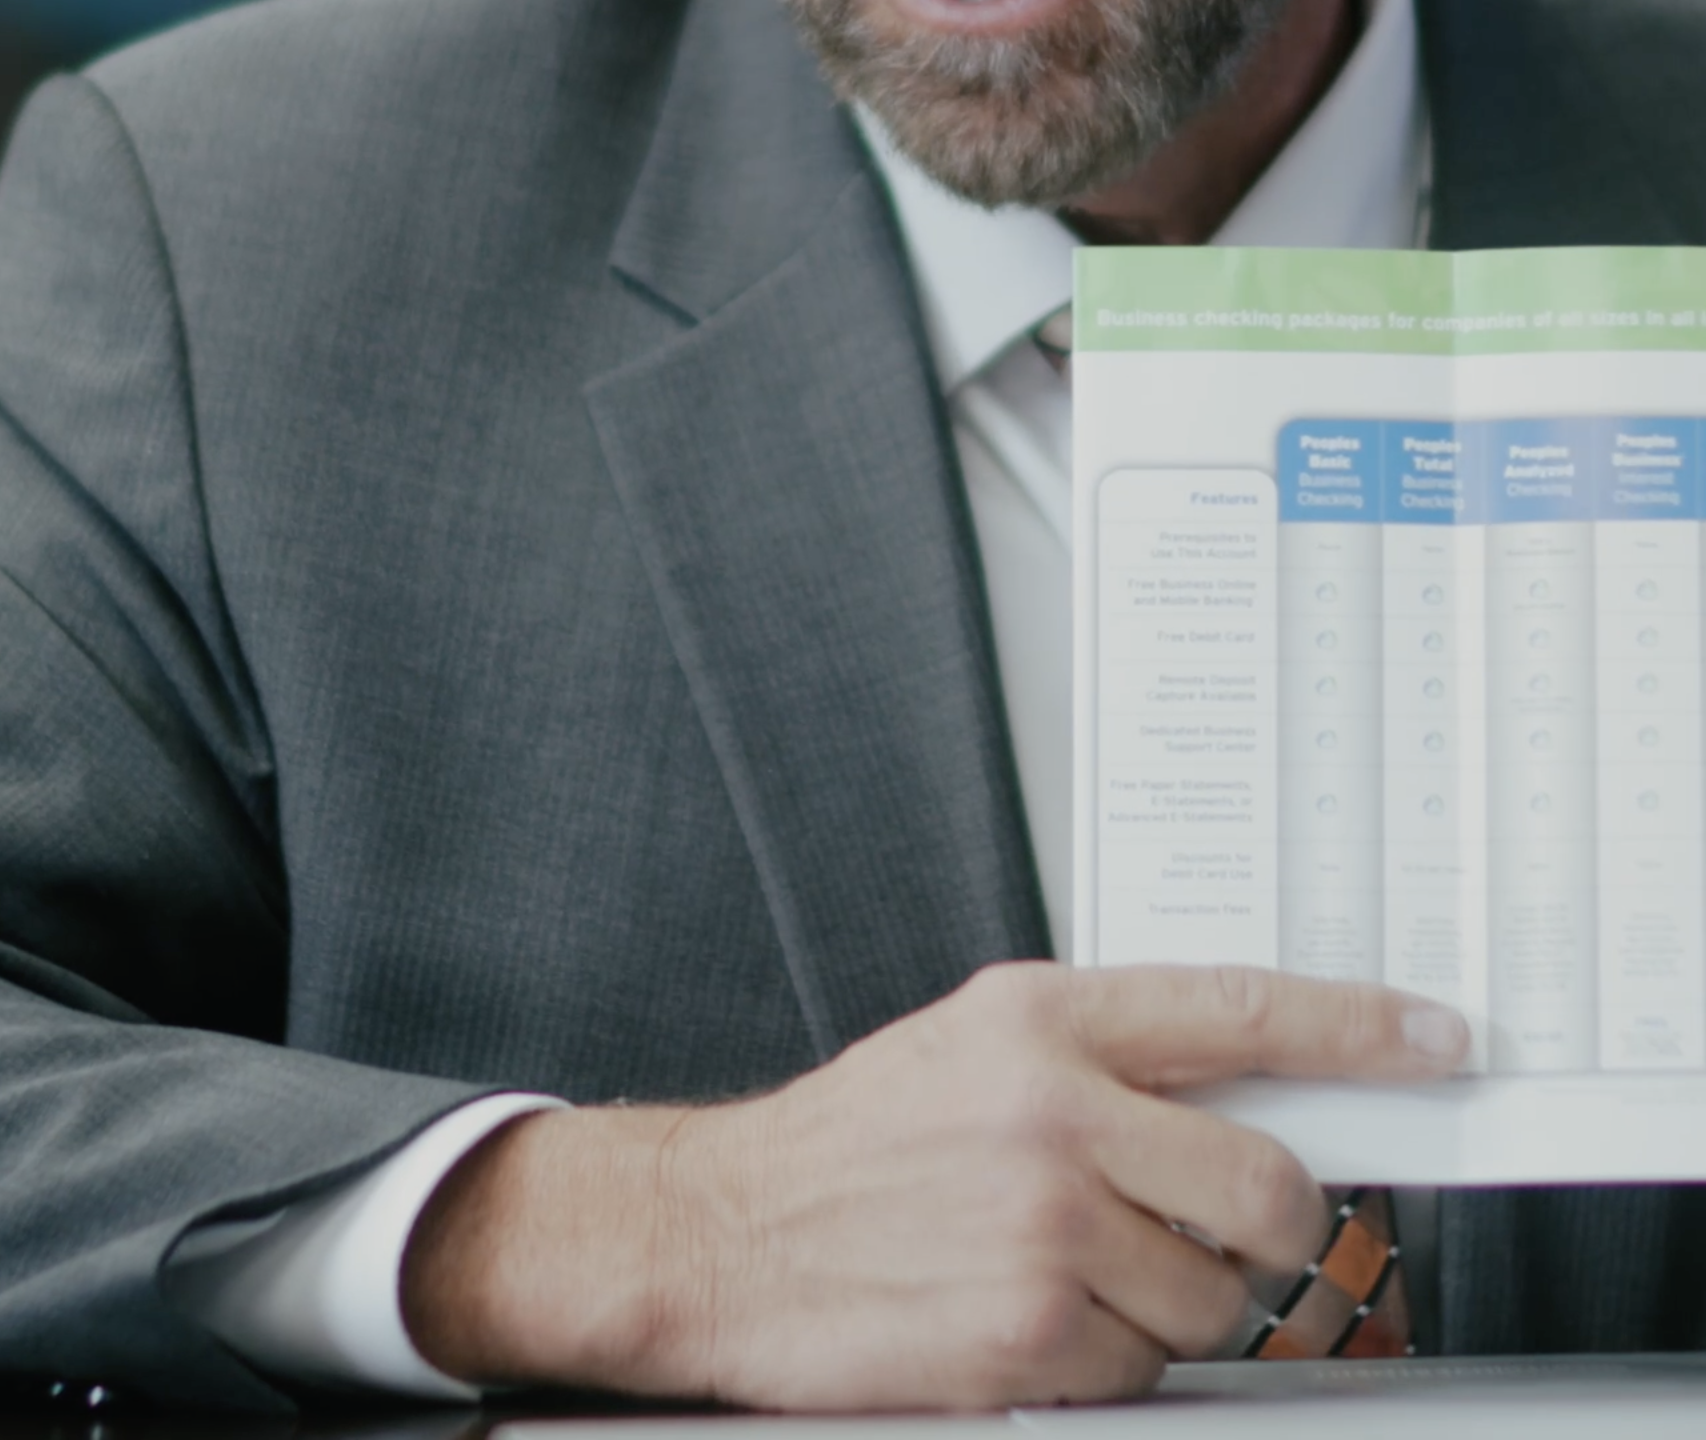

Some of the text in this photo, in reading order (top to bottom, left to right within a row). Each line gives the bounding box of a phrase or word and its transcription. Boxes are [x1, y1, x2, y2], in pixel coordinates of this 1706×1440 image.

[1097, 308, 1188, 327] Business
[1193, 308, 1283, 331] checking
[1288, 310, 1382, 332] packages
[1388, 310, 1416, 329] for
[1421, 311, 1527, 333] companies
[1533, 309, 1554, 328] of
[1589, 310, 1640, 327] sizes
[1645, 309, 1666, 328] in
[1670, 309, 1696, 328] all
[1299, 435, 1362, 451] Peoples
[1402, 436, 1462, 453] Peoples
[1308, 453, 1352, 469] Basic
[1412, 455, 1454, 471] Total
[1189, 491, 1259, 506] Features
[1177, 546, 1203, 559] This
[1127, 577, 1257, 590] Free Business Online
[1133, 595, 1157, 606] and
[1159, 594, 1201, 606] Mobile
[1156, 629, 1256, 643] Free Debit Card
[1109, 779, 1138, 791] Free
